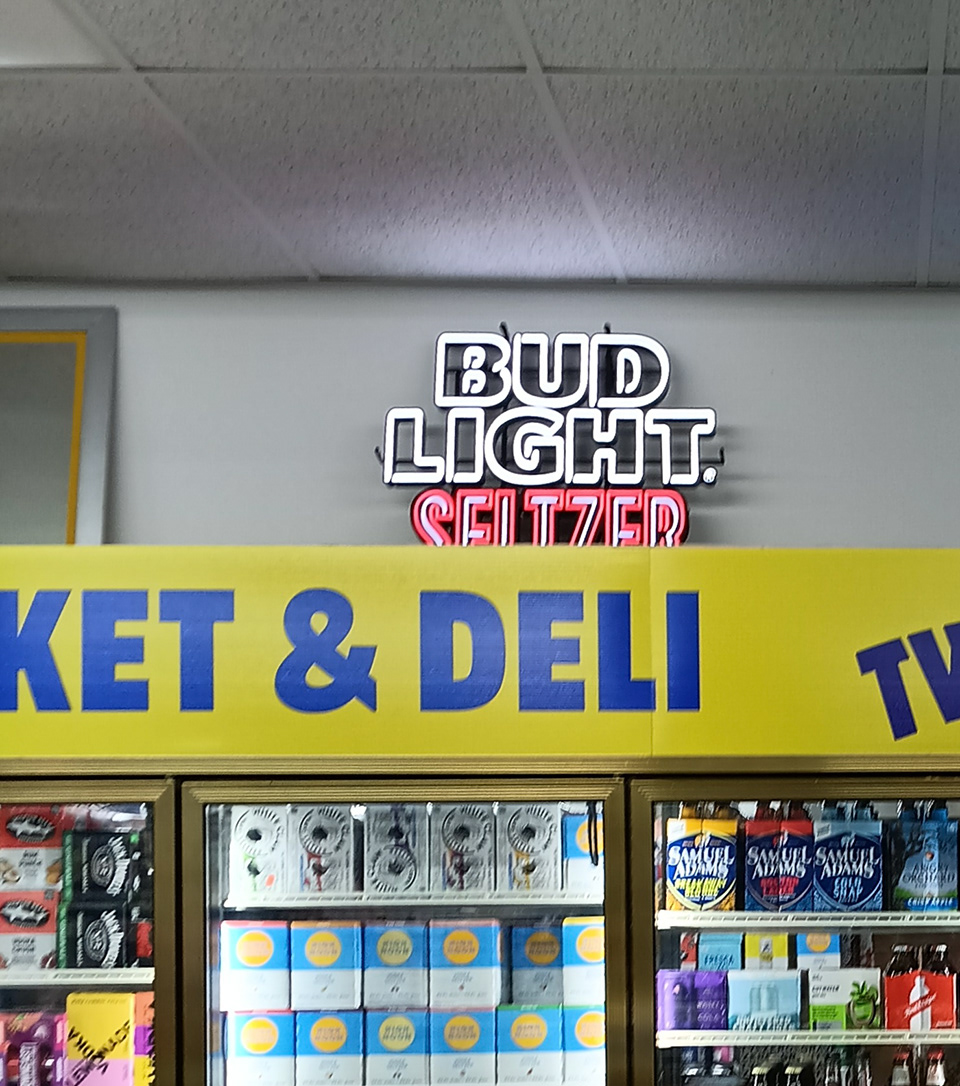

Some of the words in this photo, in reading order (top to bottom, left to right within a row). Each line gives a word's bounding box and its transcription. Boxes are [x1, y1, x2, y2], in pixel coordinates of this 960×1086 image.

[434, 331, 671, 408] BUD
[273, 587, 378, 714] &
[418, 590, 701, 712] DELI
[668, 845, 736, 866] SAMUEL
[747, 845, 813, 866] SAMUEL
[815, 846, 880, 866] SAMUEL
[673, 861, 729, 879] ADAMS
[752, 860, 807, 880] ADAMS
[820, 861, 875, 880] ADAMS
